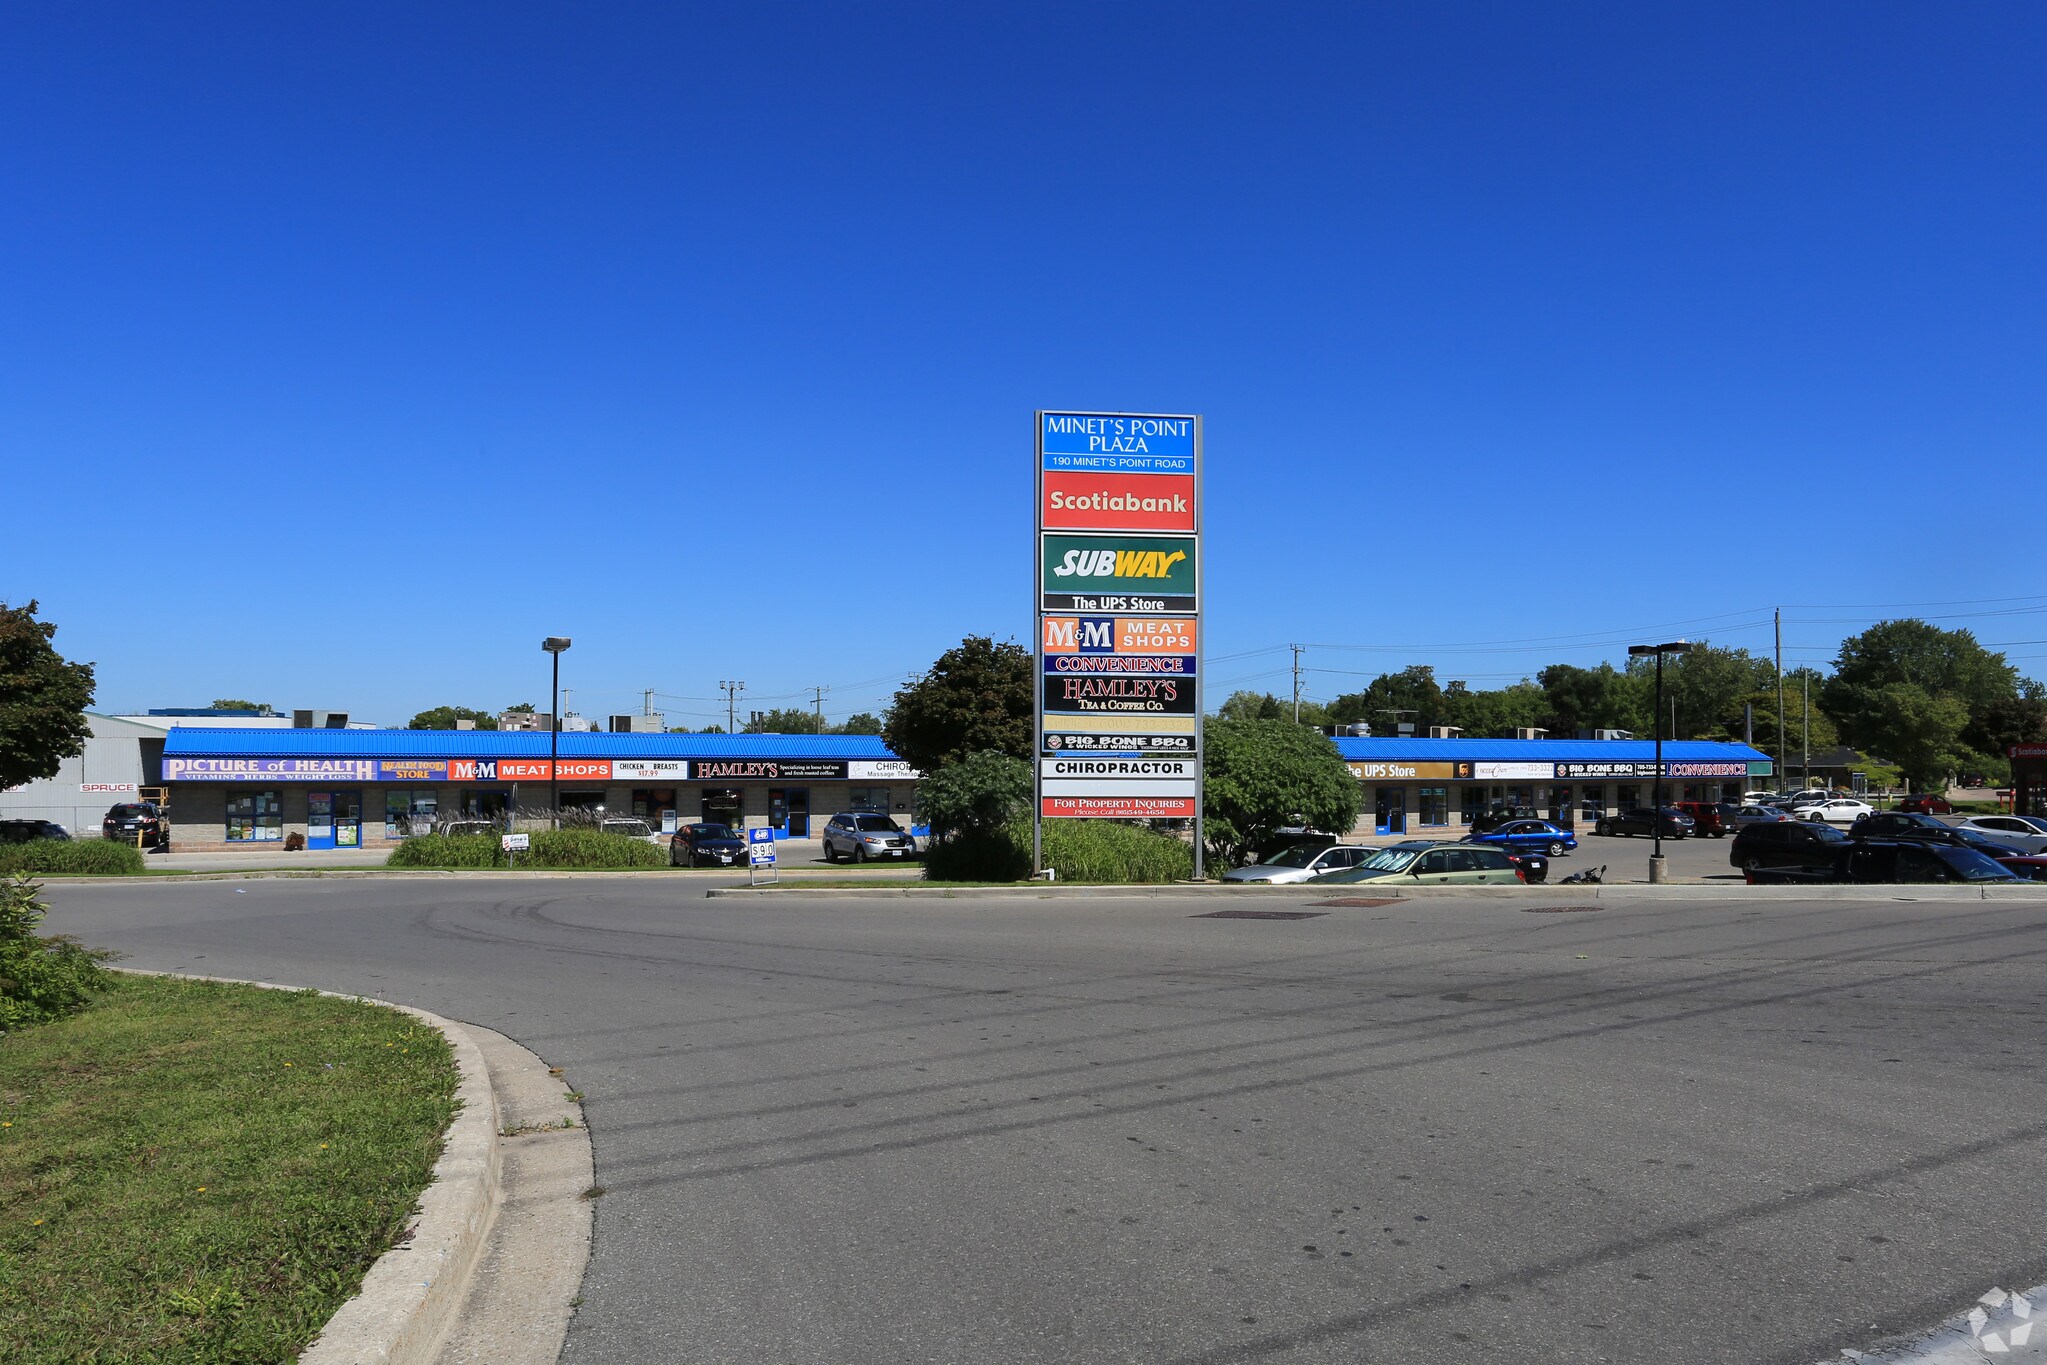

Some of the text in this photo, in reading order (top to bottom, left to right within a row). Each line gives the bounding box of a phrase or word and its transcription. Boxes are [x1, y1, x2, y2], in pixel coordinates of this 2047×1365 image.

[1048, 418, 1189, 437] MINET'S POINT
[1090, 436, 1149, 452] PLAZA
[1053, 457, 1185, 468] 190 MINET'S POINT ROAD
[1050, 491, 1187, 512] Scotiabank
[1054, 549, 1186, 578] SUBWAY
[1072, 596, 1164, 610] The UPS Store
[1046, 621, 1112, 647] M&M
[1128, 623, 1184, 634] MEAT
[1123, 636, 1190, 647] SHOPS
[1056, 657, 1183, 672] CONVENIENCE
[1063, 678, 1177, 700] HAMLEY'S
[1065, 736, 1188, 747] BIG BONE BBQ
[170, 759, 372, 780] PICTURE of HEALTH
[418, 761, 445, 771] FOOD
[455, 762, 608, 778] M&M MEAT SHOPS
[698, 762, 777, 778] HAMLEY'S
[1056, 763, 1184, 773] CHIROPRACTOR
[1348, 764, 1416, 777] he UPS Store
[1587, 764, 1612, 772] BONE
[1614, 764, 1633, 772] BBQ
[1673, 764, 1746, 776] CONVENIENCE
[396, 770, 430, 778] STORE
[1054, 799, 1185, 809] FOR PROPERTY INQUIRIES
